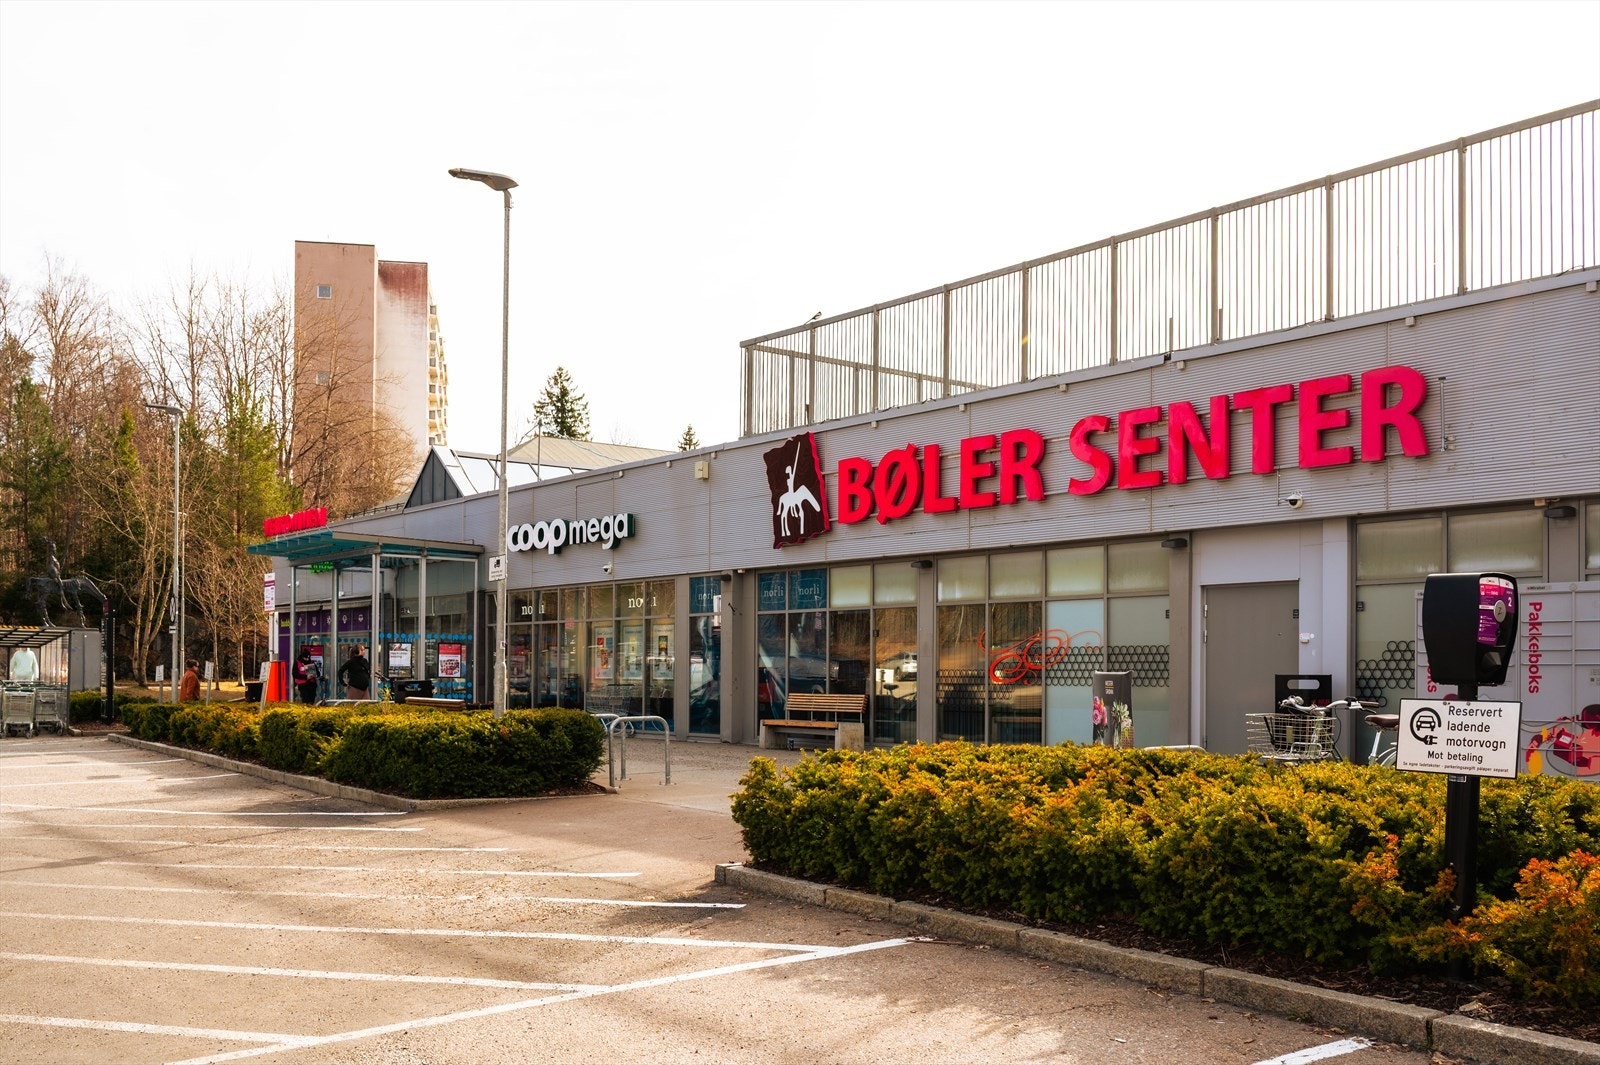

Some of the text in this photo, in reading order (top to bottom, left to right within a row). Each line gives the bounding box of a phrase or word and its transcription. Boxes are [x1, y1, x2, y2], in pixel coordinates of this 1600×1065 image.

[837, 365, 1430, 525] BØLER SENTER
[507, 513, 630, 555] coop mega
[763, 587, 784, 598] norli
[799, 584, 820, 595] norli
[521, 600, 545, 616] noli
[1507, 596, 1512, 607] 2
[1528, 601, 1543, 694] Pakkeboks
[1448, 705, 1503, 718] Reservert
[1447, 721, 1490, 733] ladende
[1446, 738, 1506, 751] motorvogn
[1427, 750, 1483, 764] Mot betaling
